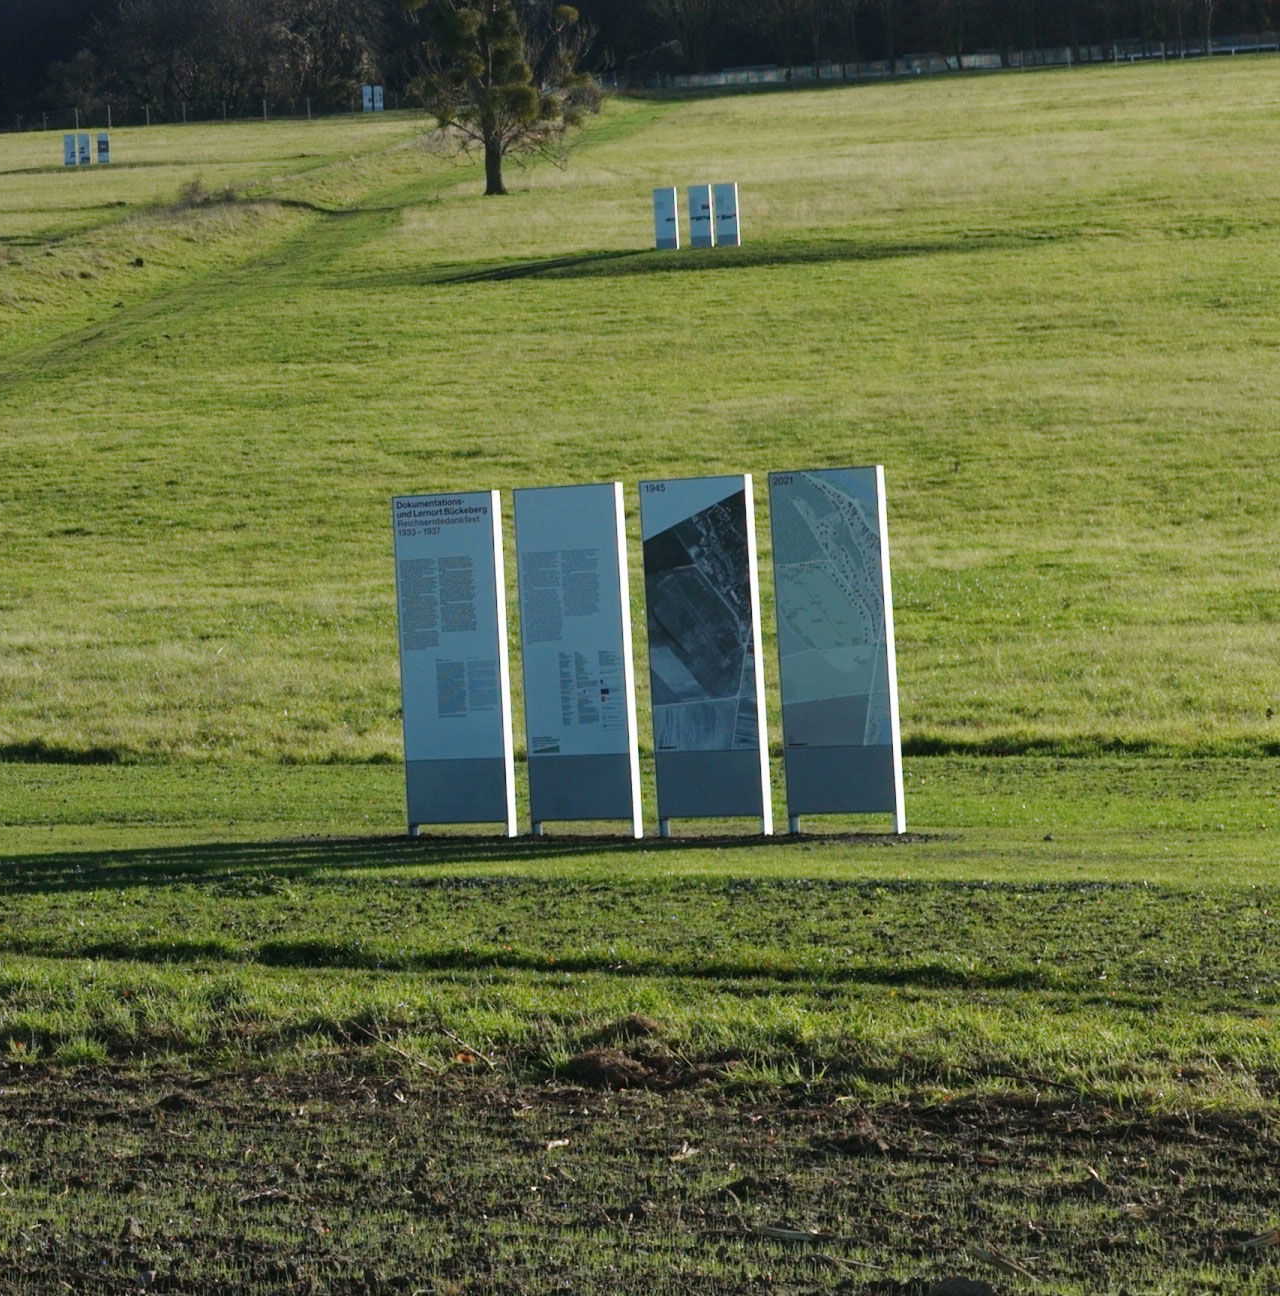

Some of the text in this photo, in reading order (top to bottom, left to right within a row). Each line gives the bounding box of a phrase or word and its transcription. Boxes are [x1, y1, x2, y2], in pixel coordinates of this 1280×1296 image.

[772, 477, 793, 485] 2021
[645, 483, 665, 493] 1945
[396, 499, 465, 509] Dokumentations-
[397, 505, 487, 518] und Lernort Bückeberg
[397, 516, 480, 527] Reichserntedankfest
[398, 528, 416, 536] 1933
[424, 527, 441, 535] 1937
